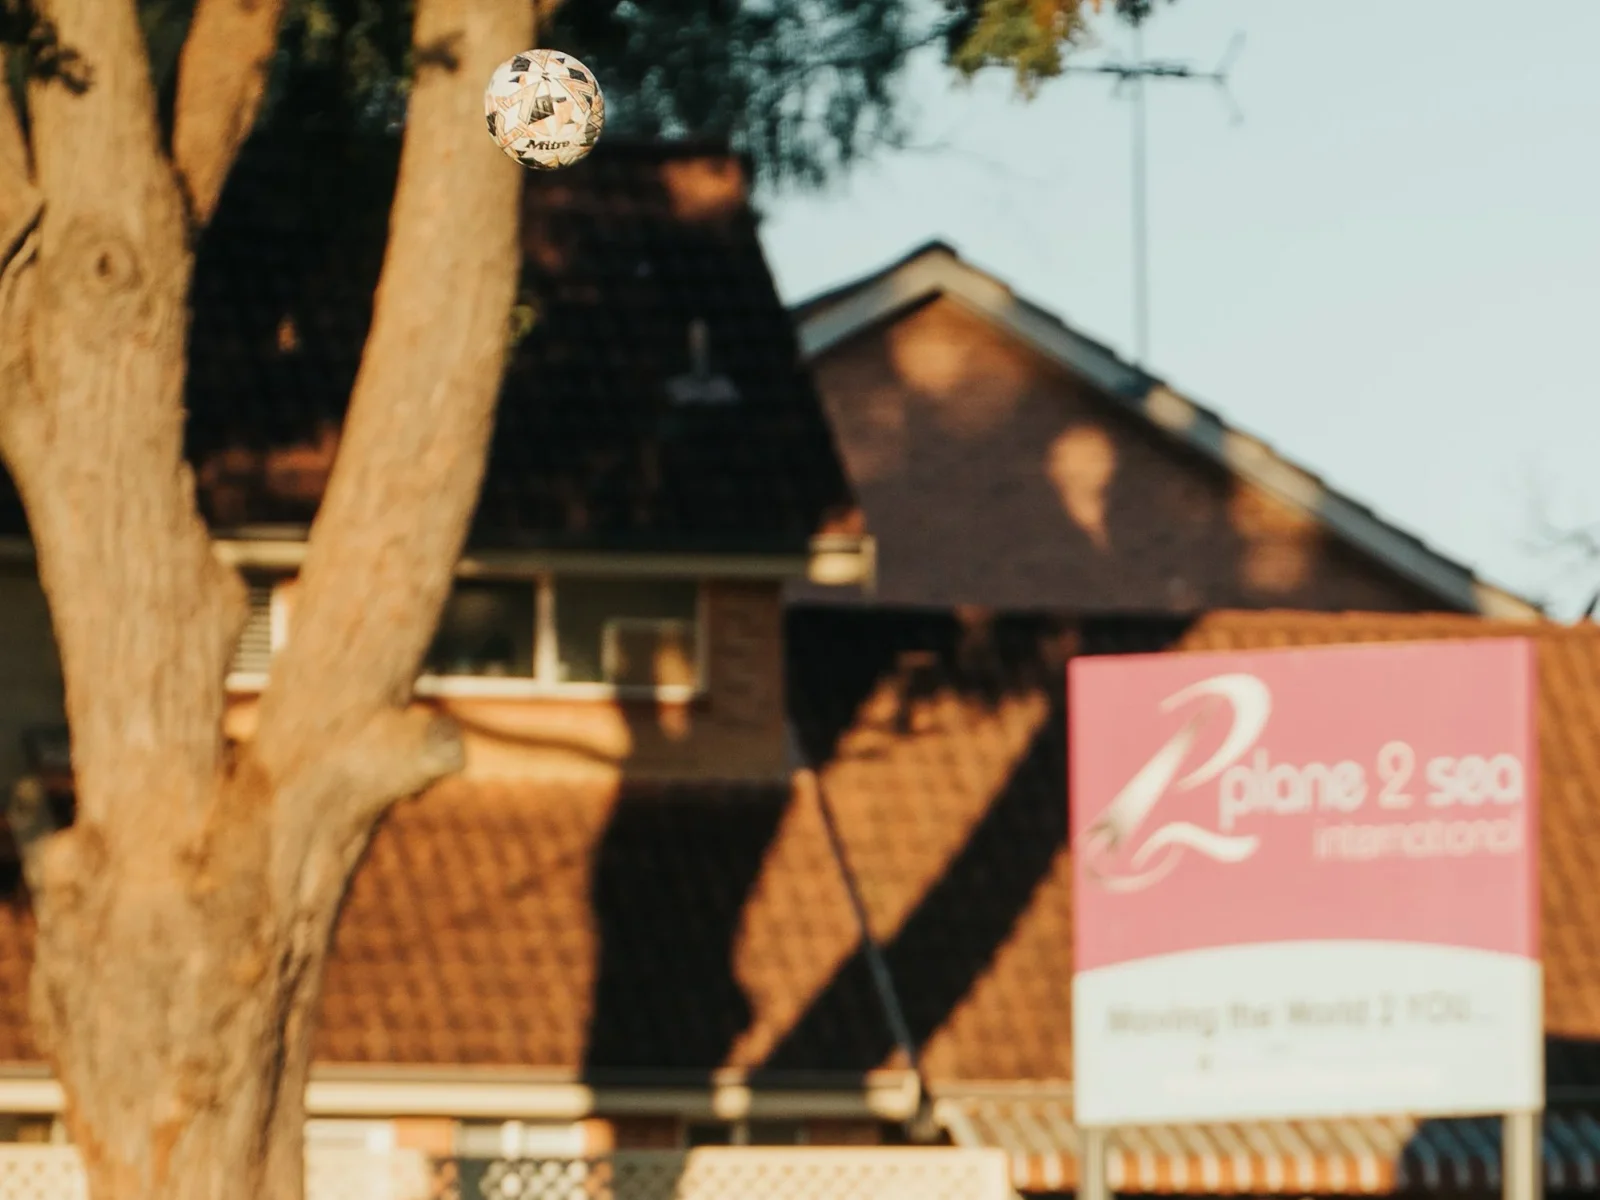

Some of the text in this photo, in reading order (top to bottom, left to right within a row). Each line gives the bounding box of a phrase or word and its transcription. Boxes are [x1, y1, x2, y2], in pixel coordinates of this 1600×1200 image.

[525, 139, 570, 151] Mitre
[1218, 740, 1522, 832] plane 2 sea
[1313, 811, 1522, 861] international
